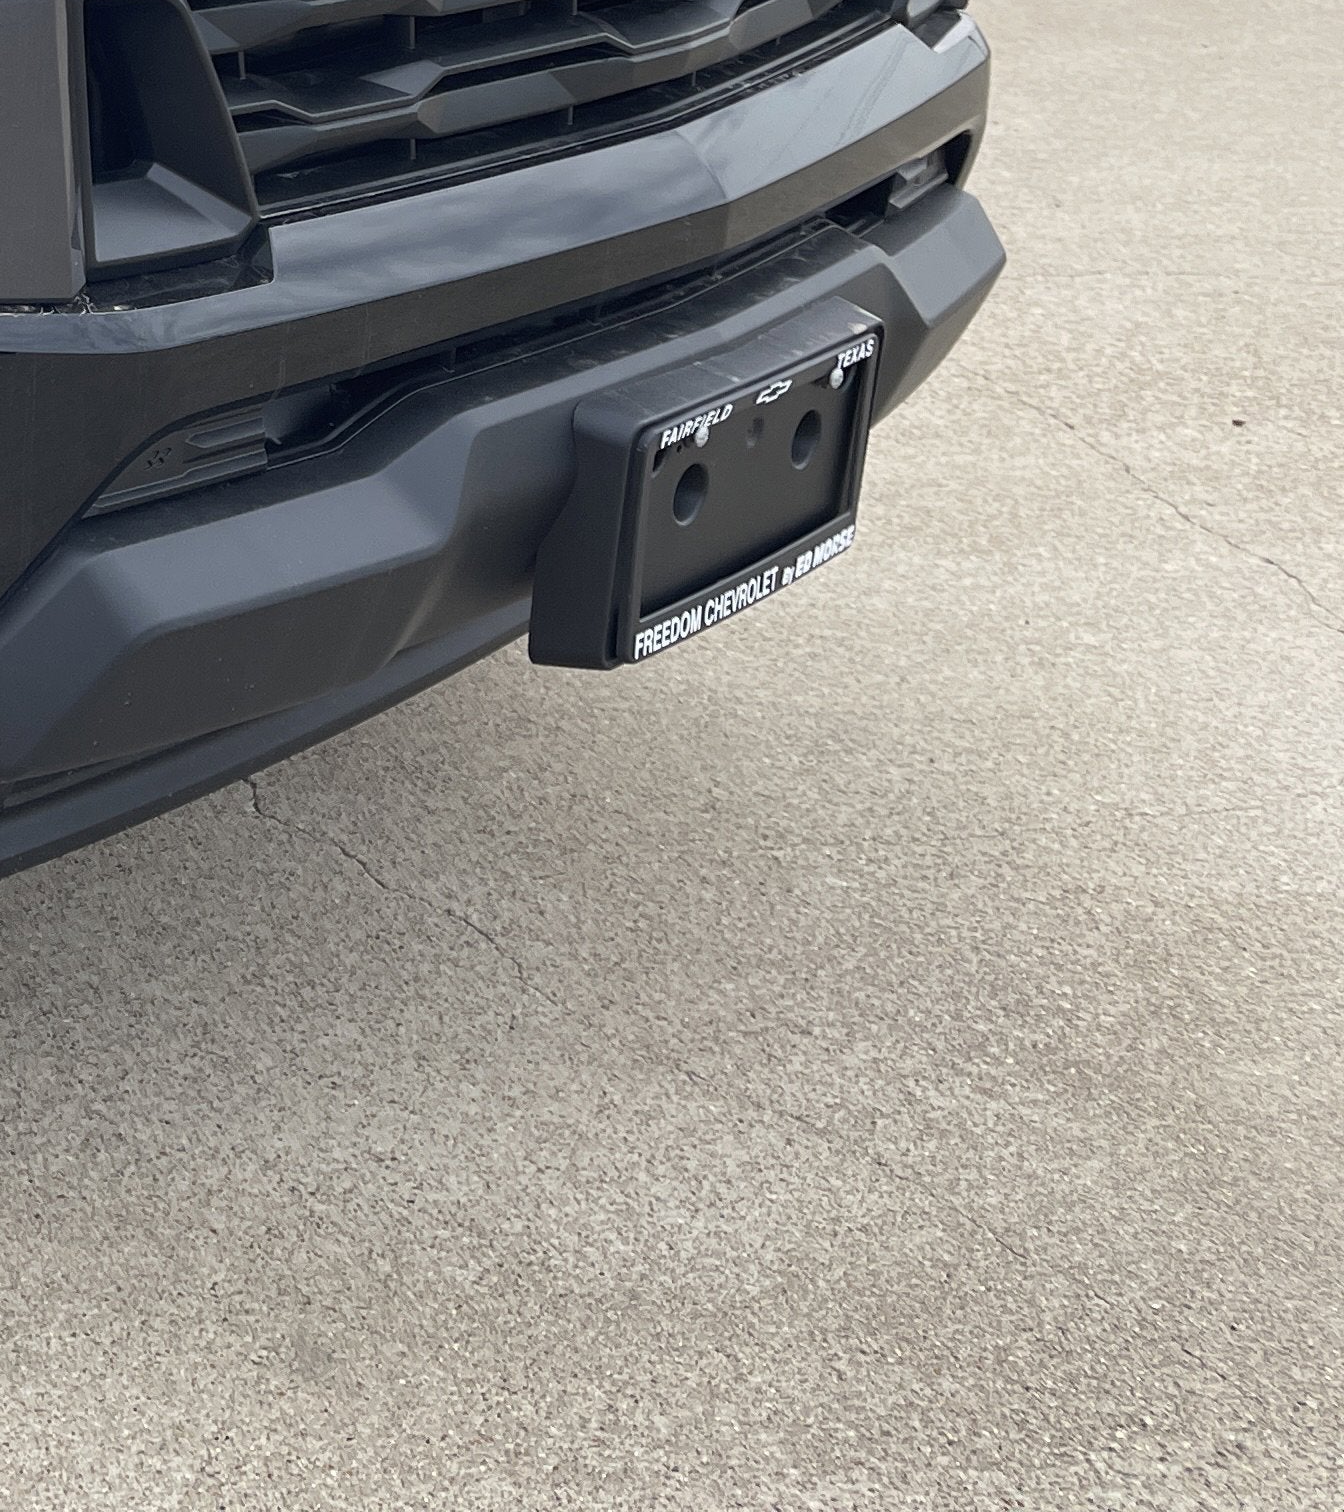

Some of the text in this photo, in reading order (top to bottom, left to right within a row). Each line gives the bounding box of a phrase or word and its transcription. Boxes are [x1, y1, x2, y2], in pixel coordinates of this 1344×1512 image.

[659, 339, 875, 450] FAIRFIELD TEXAS
[633, 606, 703, 660] FREEDOM
[703, 567, 779, 626] CHEVROLET
[795, 550, 813, 579] ED
[812, 524, 856, 568] MORSE
